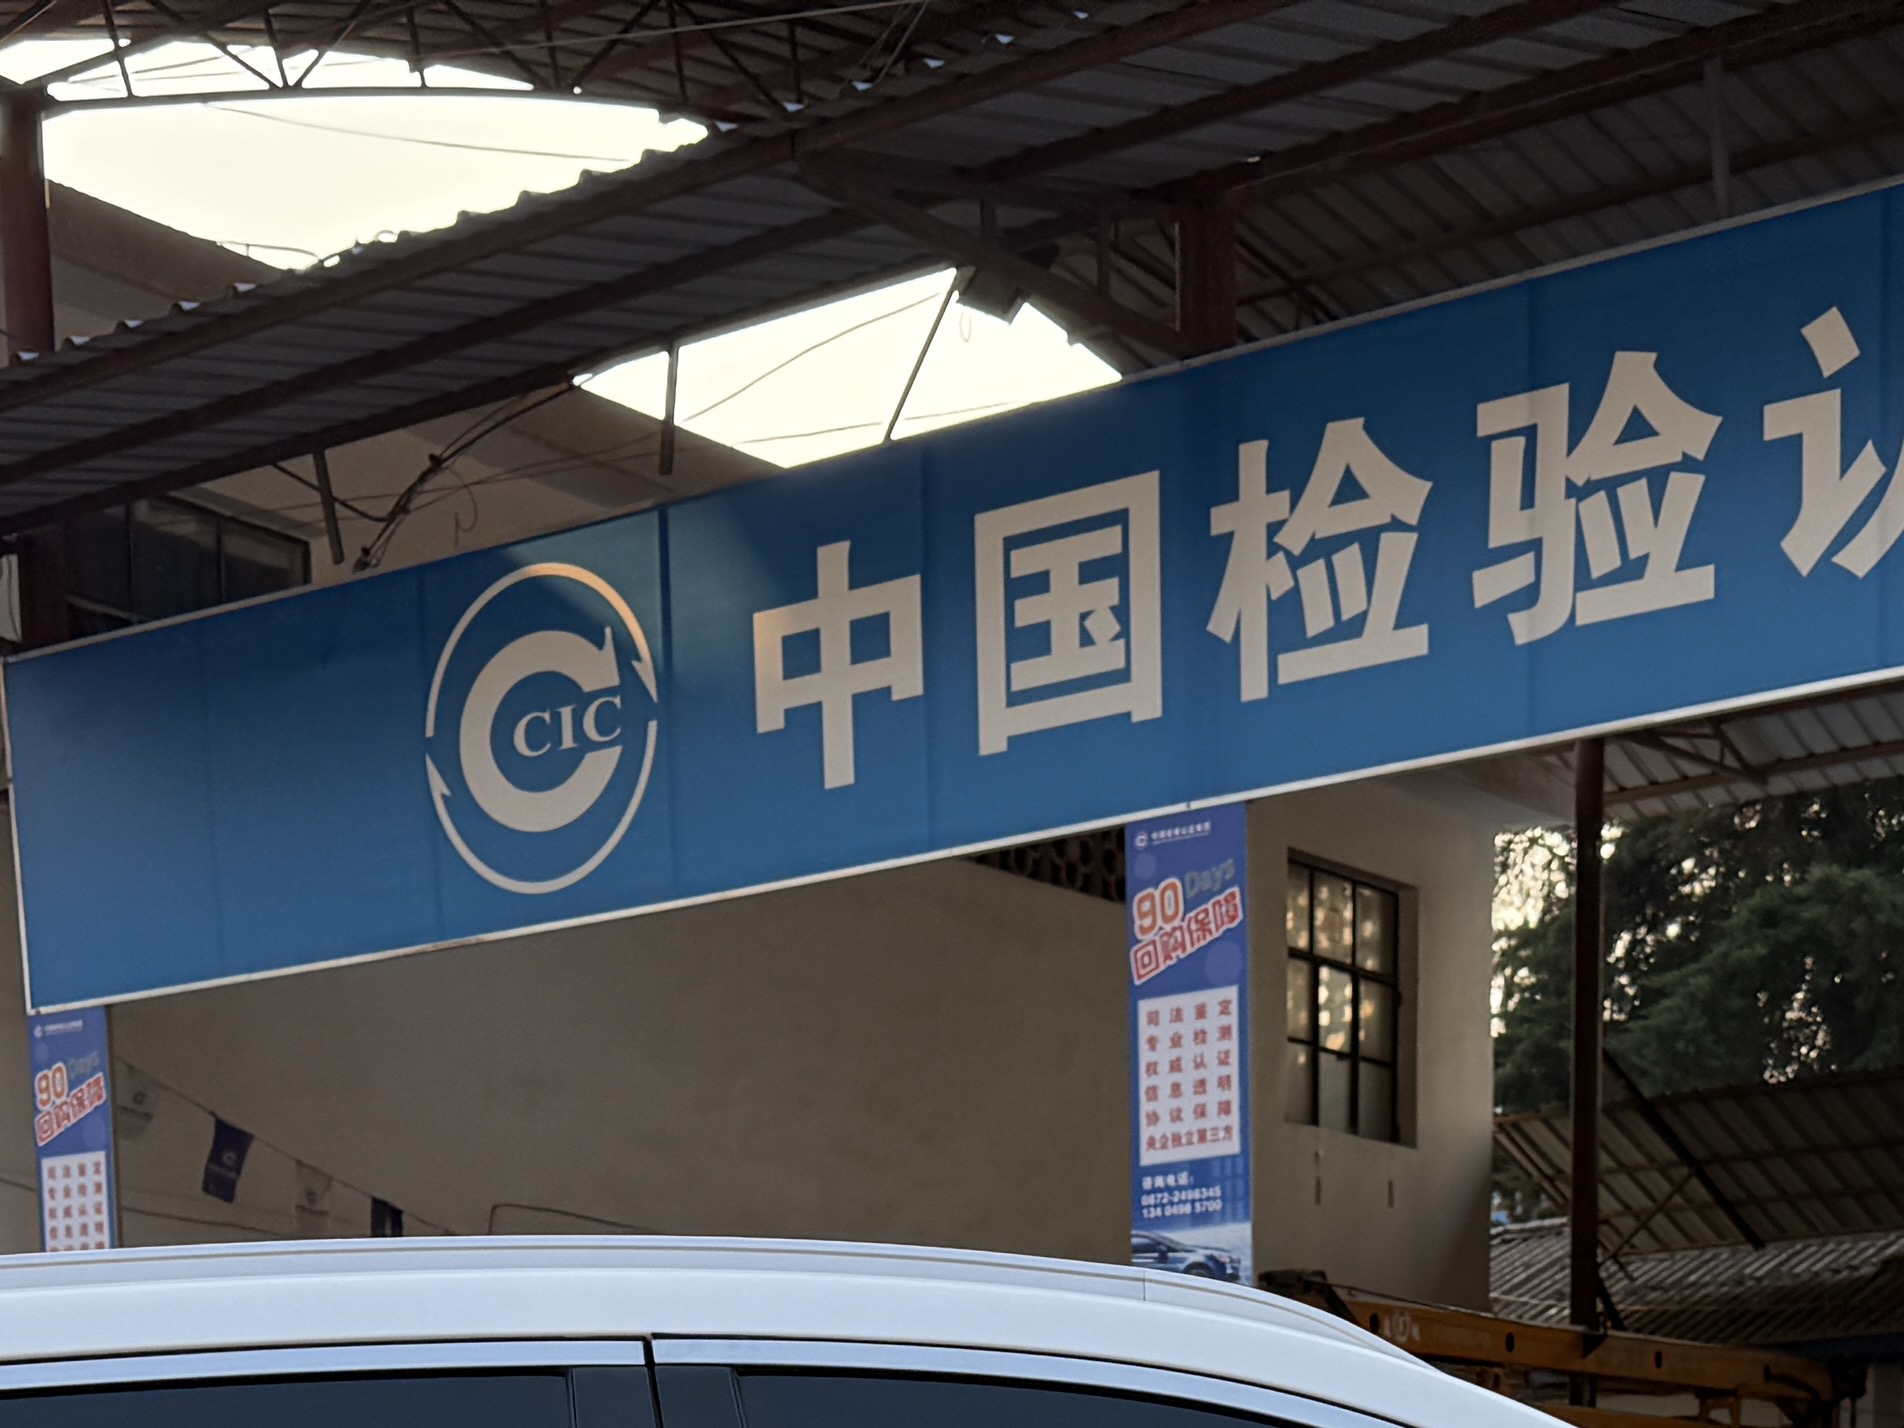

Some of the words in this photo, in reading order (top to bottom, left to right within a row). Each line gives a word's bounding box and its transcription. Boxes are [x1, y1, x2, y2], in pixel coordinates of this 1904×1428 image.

[511, 695, 623, 758] CIC
[1133, 877, 1184, 940] 90
[35, 1062, 68, 1111] 90
